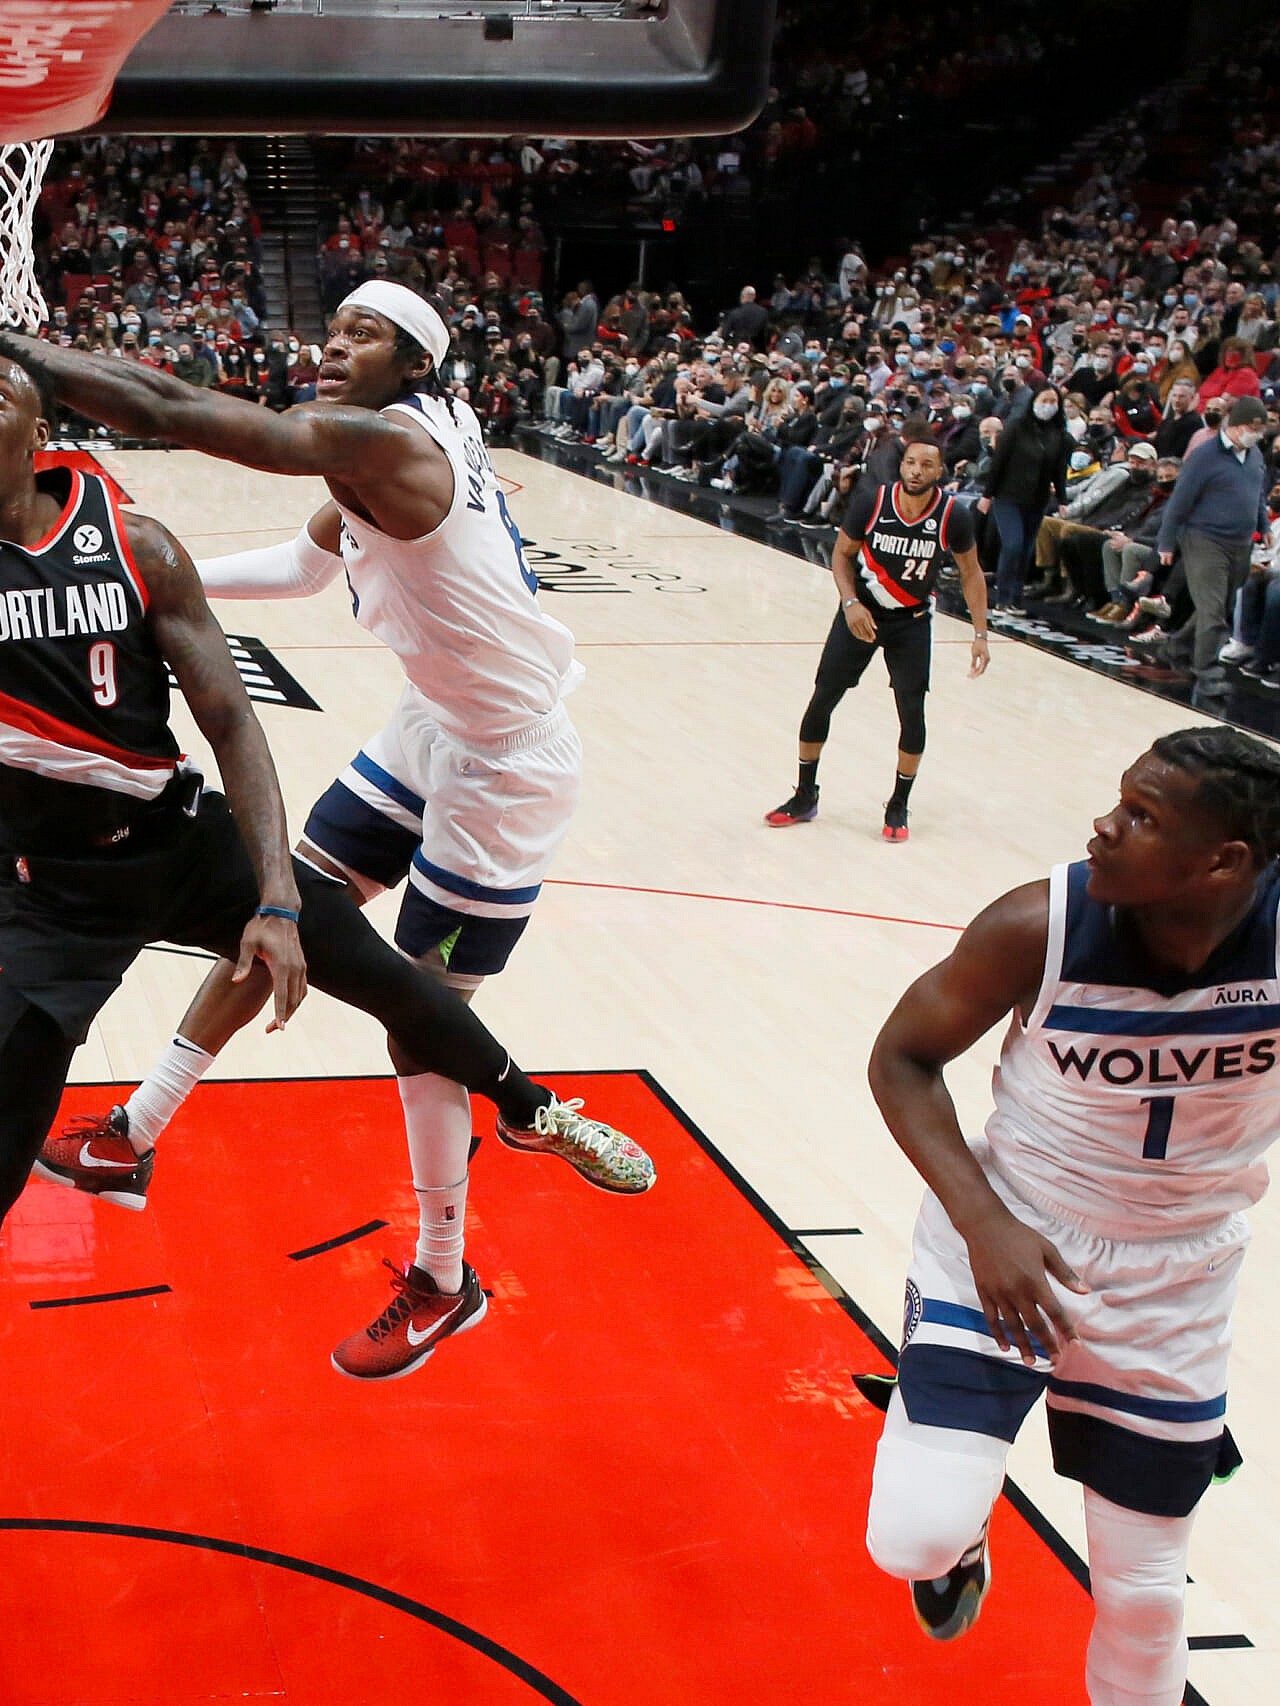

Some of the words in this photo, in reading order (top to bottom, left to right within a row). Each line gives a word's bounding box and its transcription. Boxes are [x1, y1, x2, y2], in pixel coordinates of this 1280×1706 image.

[73, 552, 111, 565] StormX
[872, 531, 936, 559] PORTLAND
[901, 559, 929, 580] 24
[90, 642, 117, 707] 9
[1047, 1038, 1276, 1085] WOLVES
[1140, 1096, 1176, 1160] 1
